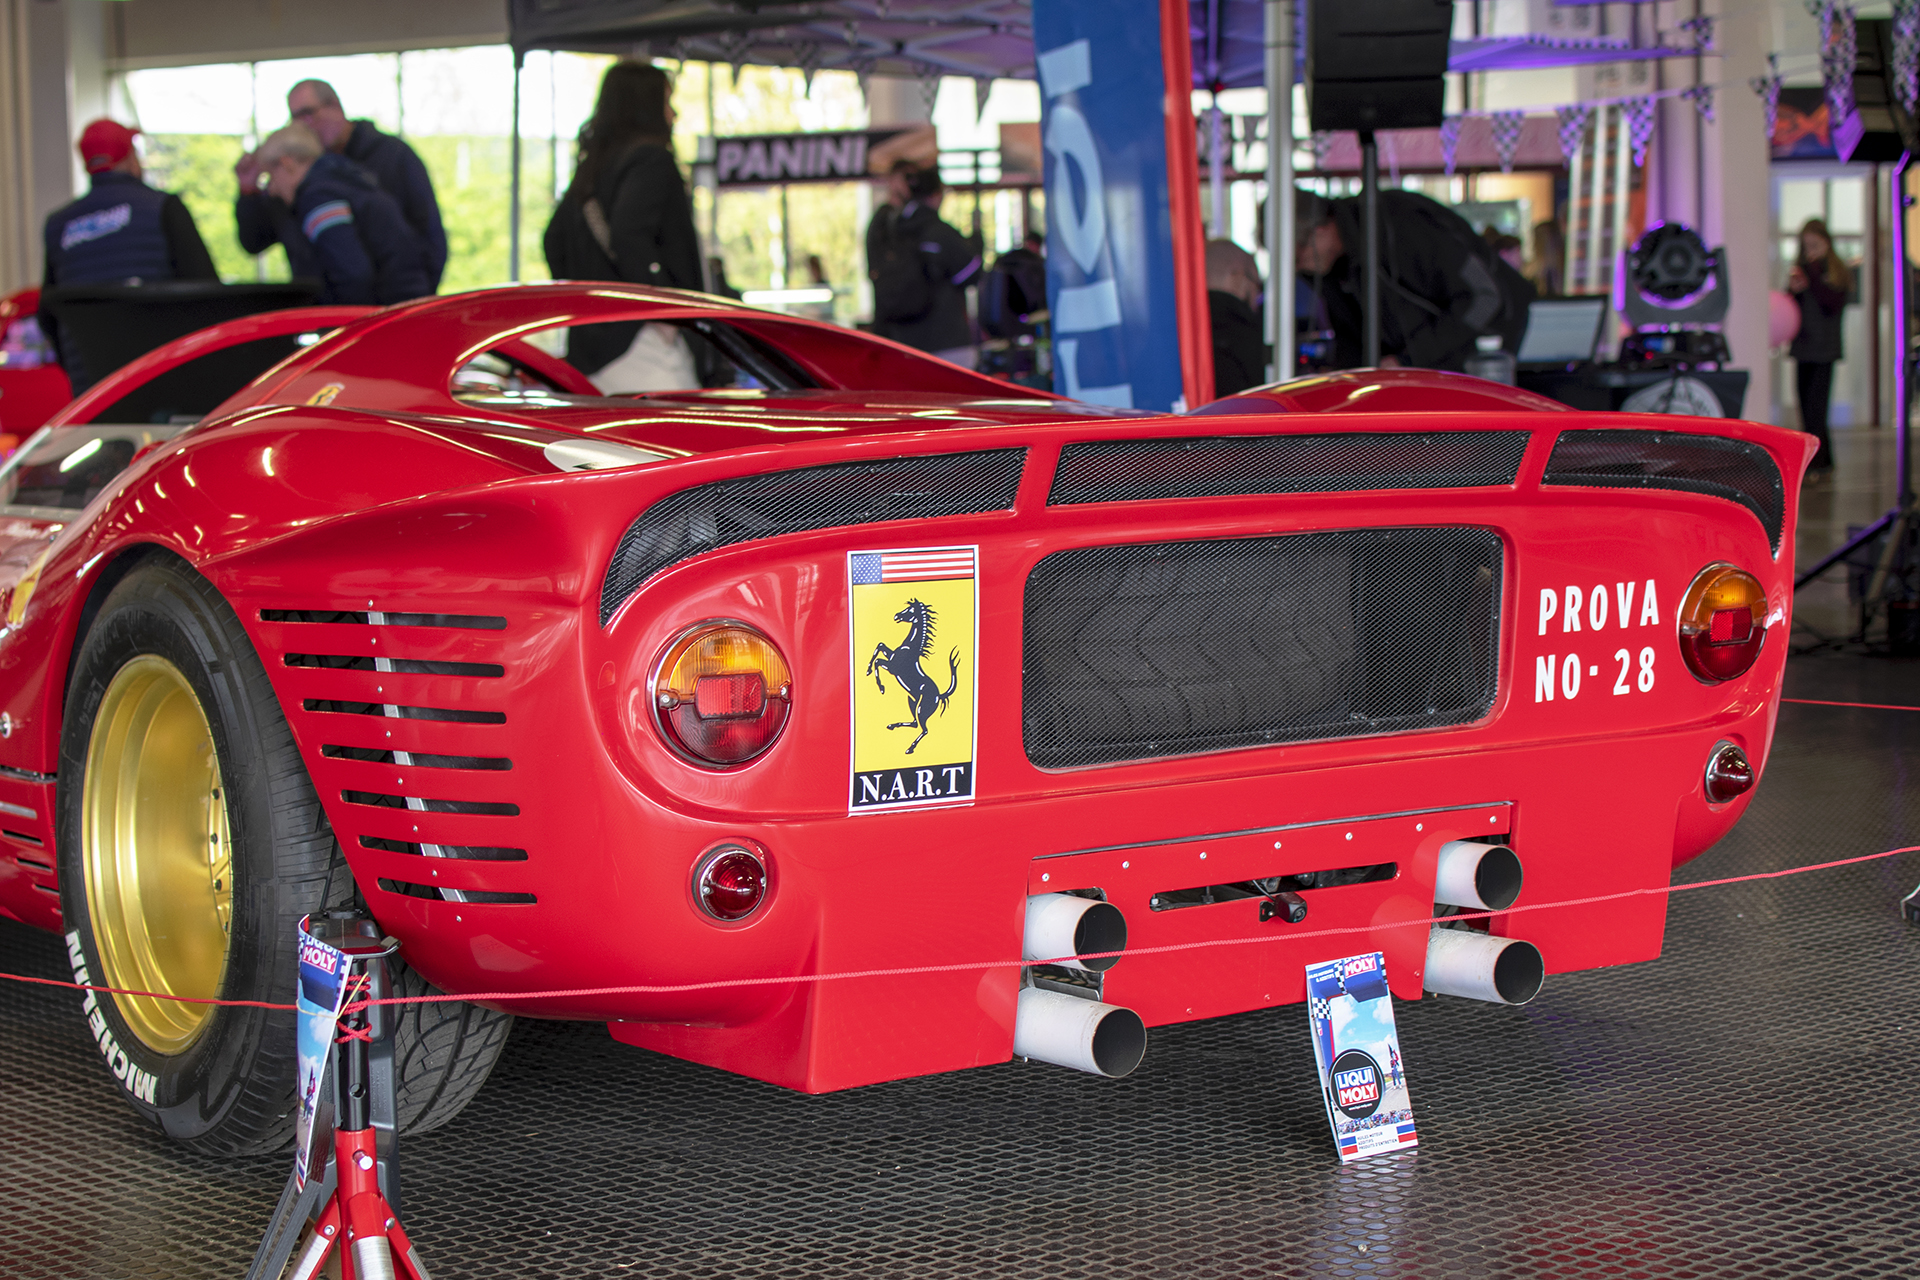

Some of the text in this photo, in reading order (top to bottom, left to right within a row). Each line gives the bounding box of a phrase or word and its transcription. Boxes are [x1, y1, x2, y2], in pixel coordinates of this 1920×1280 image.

[718, 136, 868, 180] PANINI
[1538, 579, 1659, 636] PROVA
[1613, 646, 1655, 696] 28
[859, 766, 964, 803] N.A.R.T
[303, 946, 337, 971] MOLY
[1345, 957, 1376, 978] MOLY
[65, 929, 158, 1105] MICHELIN
[1337, 1068, 1374, 1089] LIQUI
[1340, 1083, 1375, 1104] MOLY
